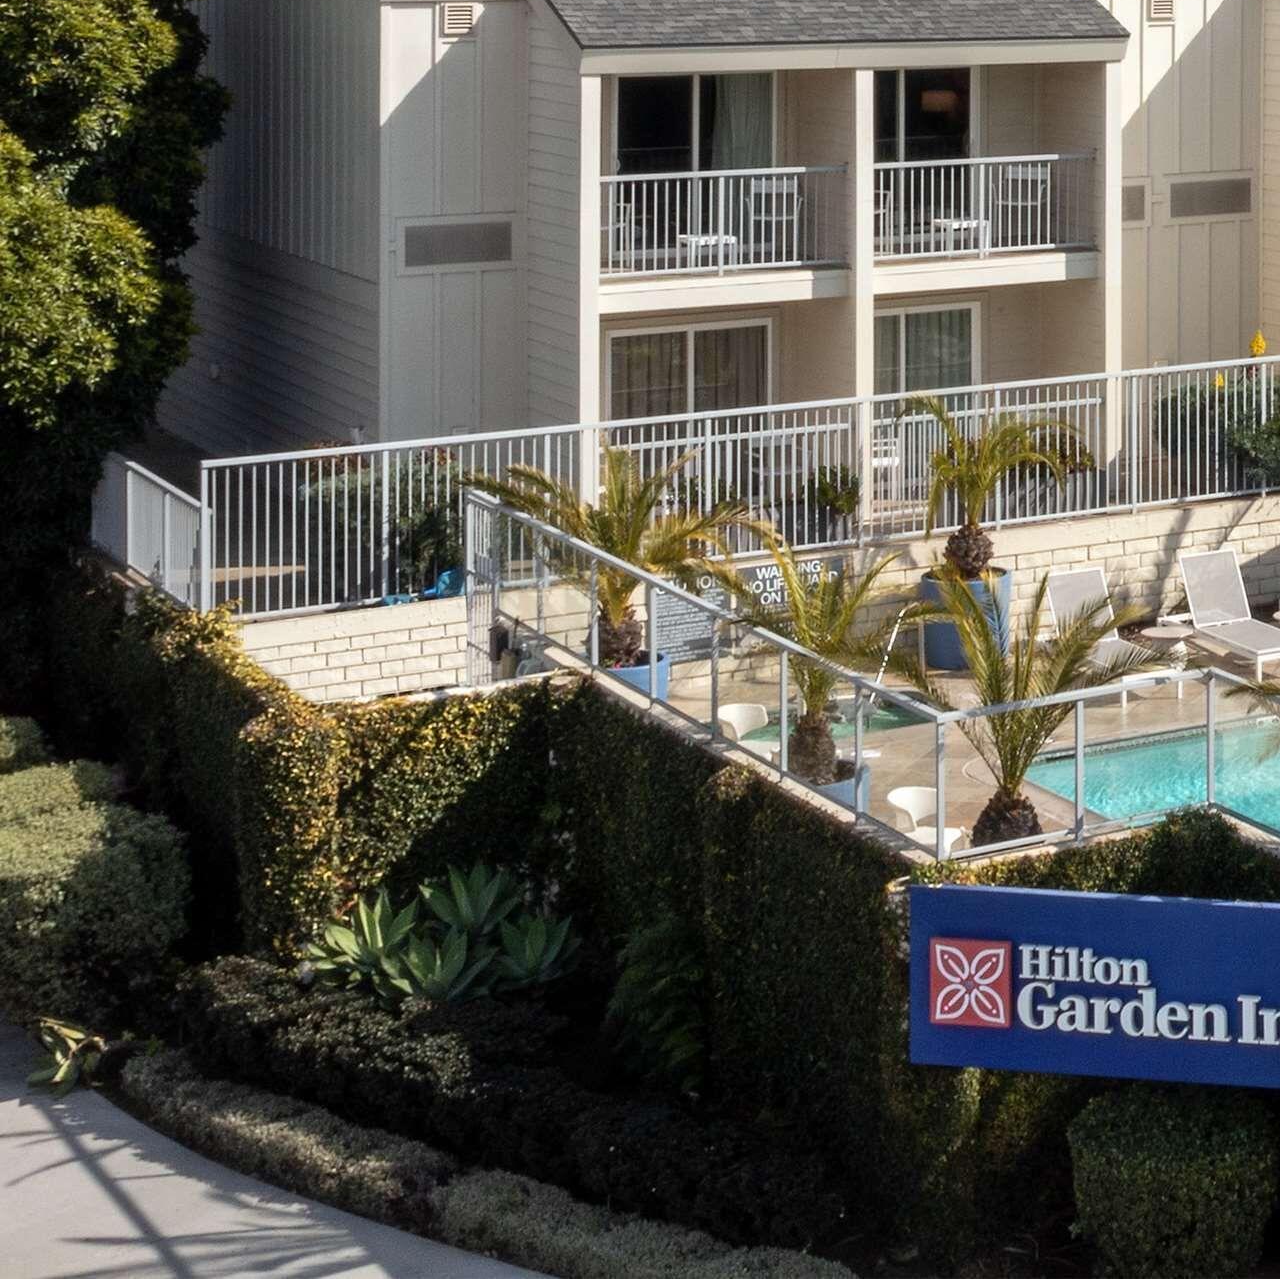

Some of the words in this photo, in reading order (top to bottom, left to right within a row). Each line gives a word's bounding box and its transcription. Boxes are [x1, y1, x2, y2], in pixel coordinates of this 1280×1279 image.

[761, 591, 781, 605] ON
[1019, 943, 1151, 986] Hilton
[1017, 981, 1232, 1042] Garden
